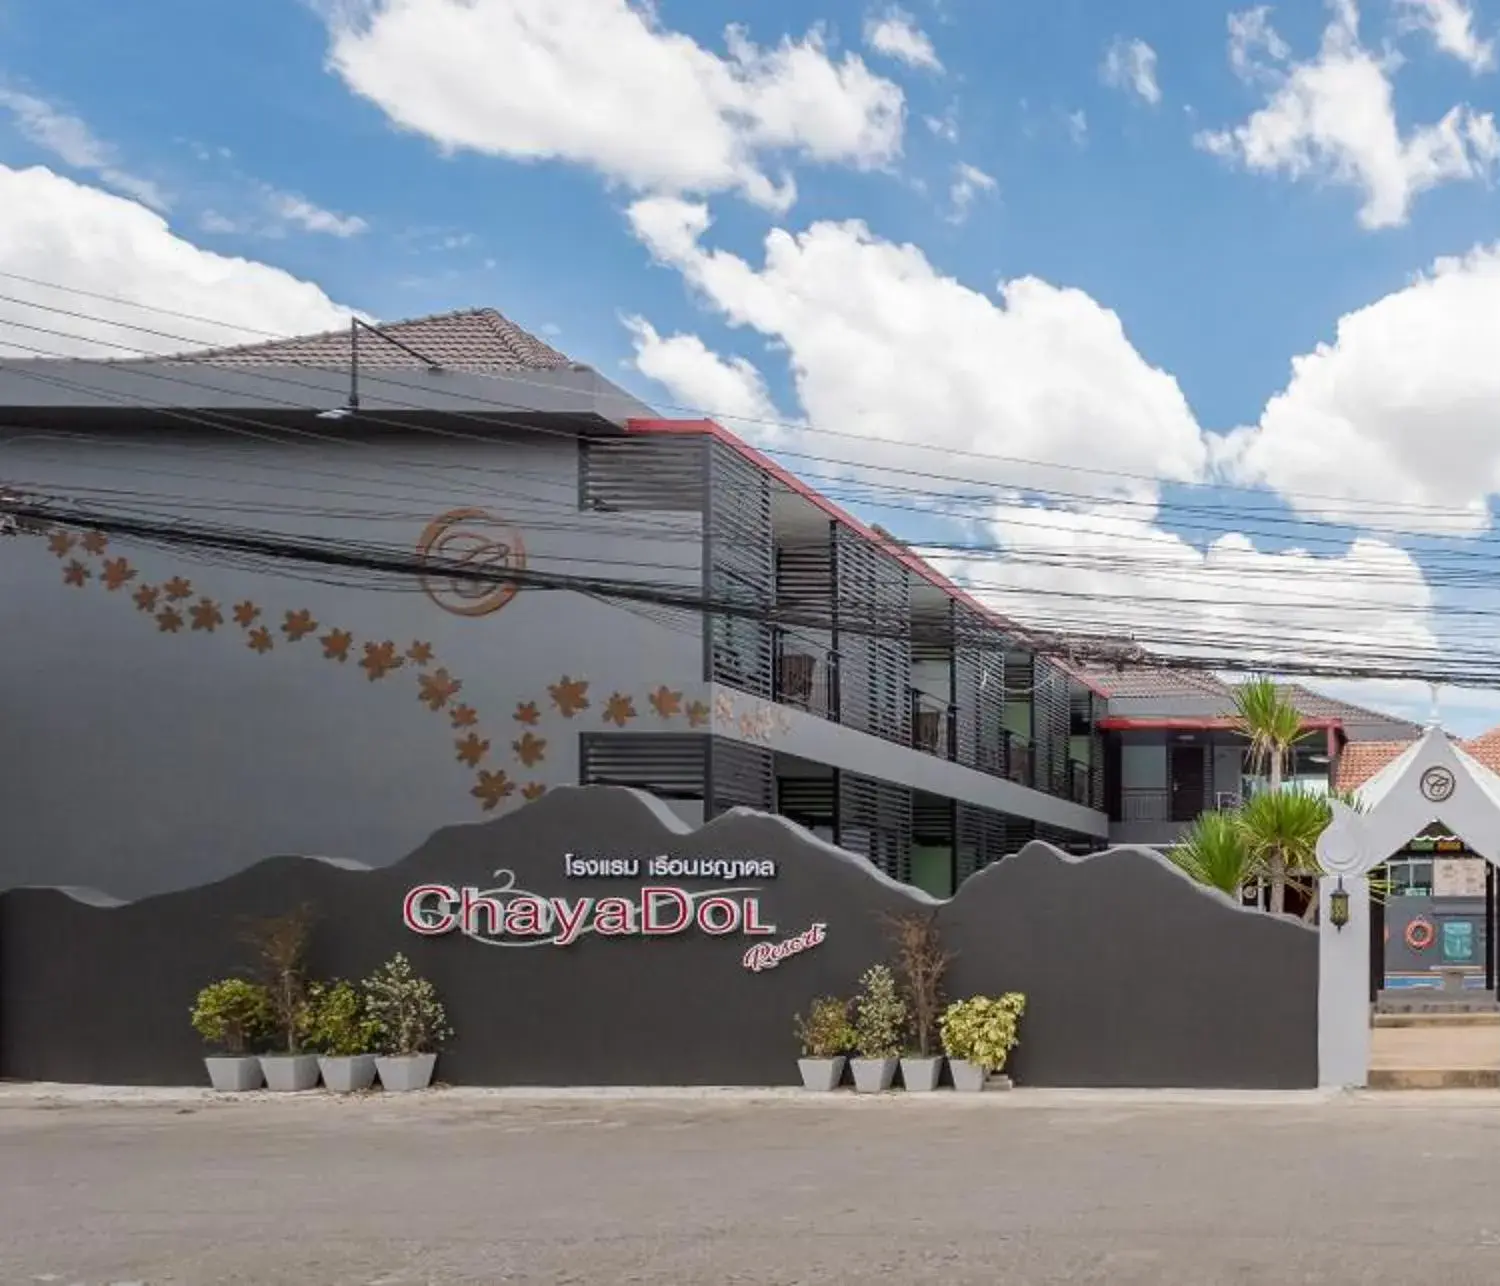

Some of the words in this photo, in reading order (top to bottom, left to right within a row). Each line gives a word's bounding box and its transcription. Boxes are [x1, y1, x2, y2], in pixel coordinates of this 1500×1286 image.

[565, 853, 640, 876] โรงแรม
[649, 854, 776, 879] เรือนชญาดล
[743, 923, 827, 972] Resort
